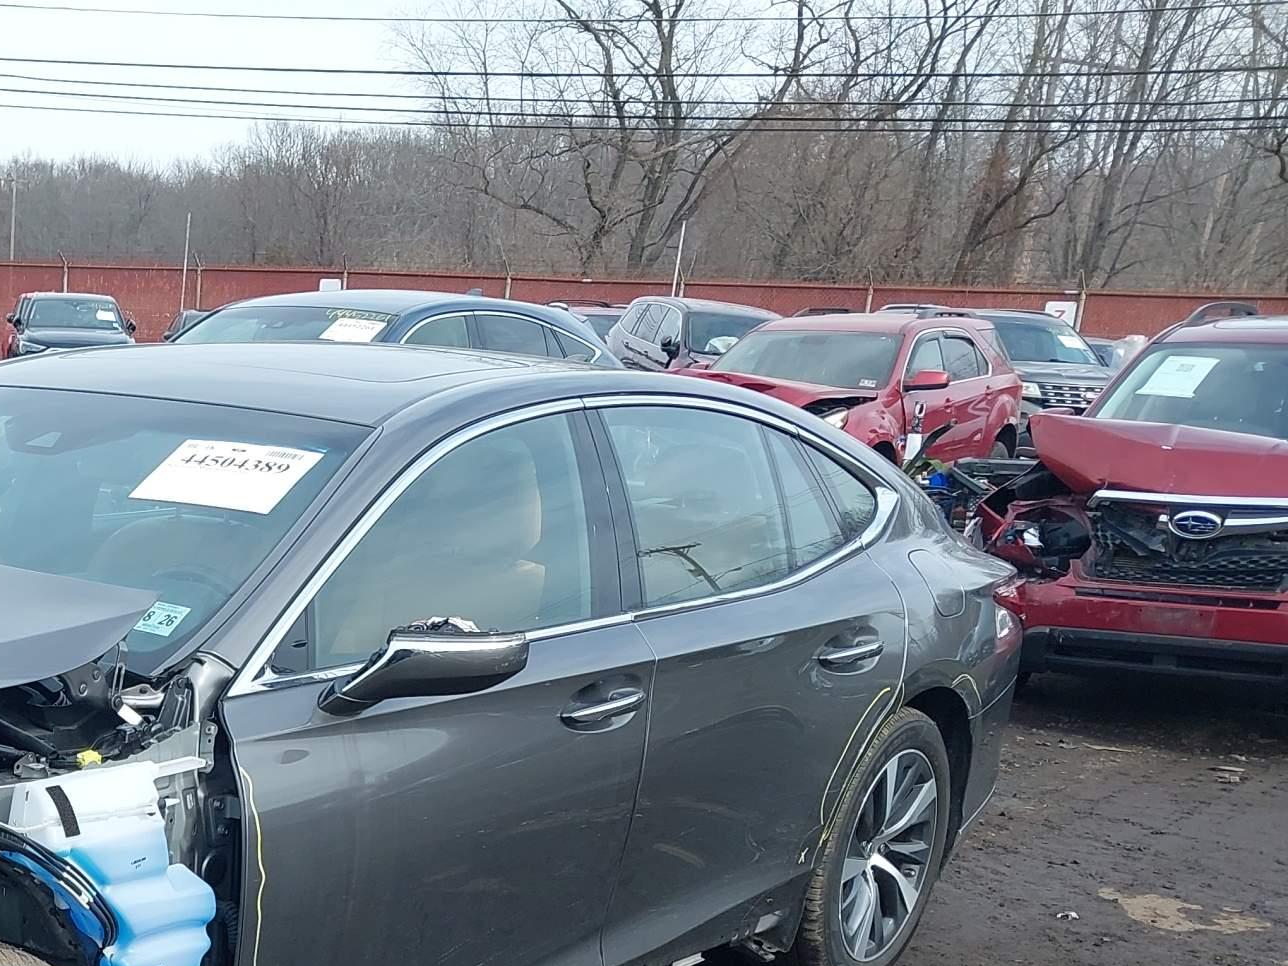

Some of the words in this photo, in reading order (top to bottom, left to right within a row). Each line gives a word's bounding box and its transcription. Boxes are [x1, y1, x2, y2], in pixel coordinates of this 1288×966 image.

[180, 453, 291, 474] 44504389
[143, 610, 156, 622] 8
[157, 613, 178, 627] 26
